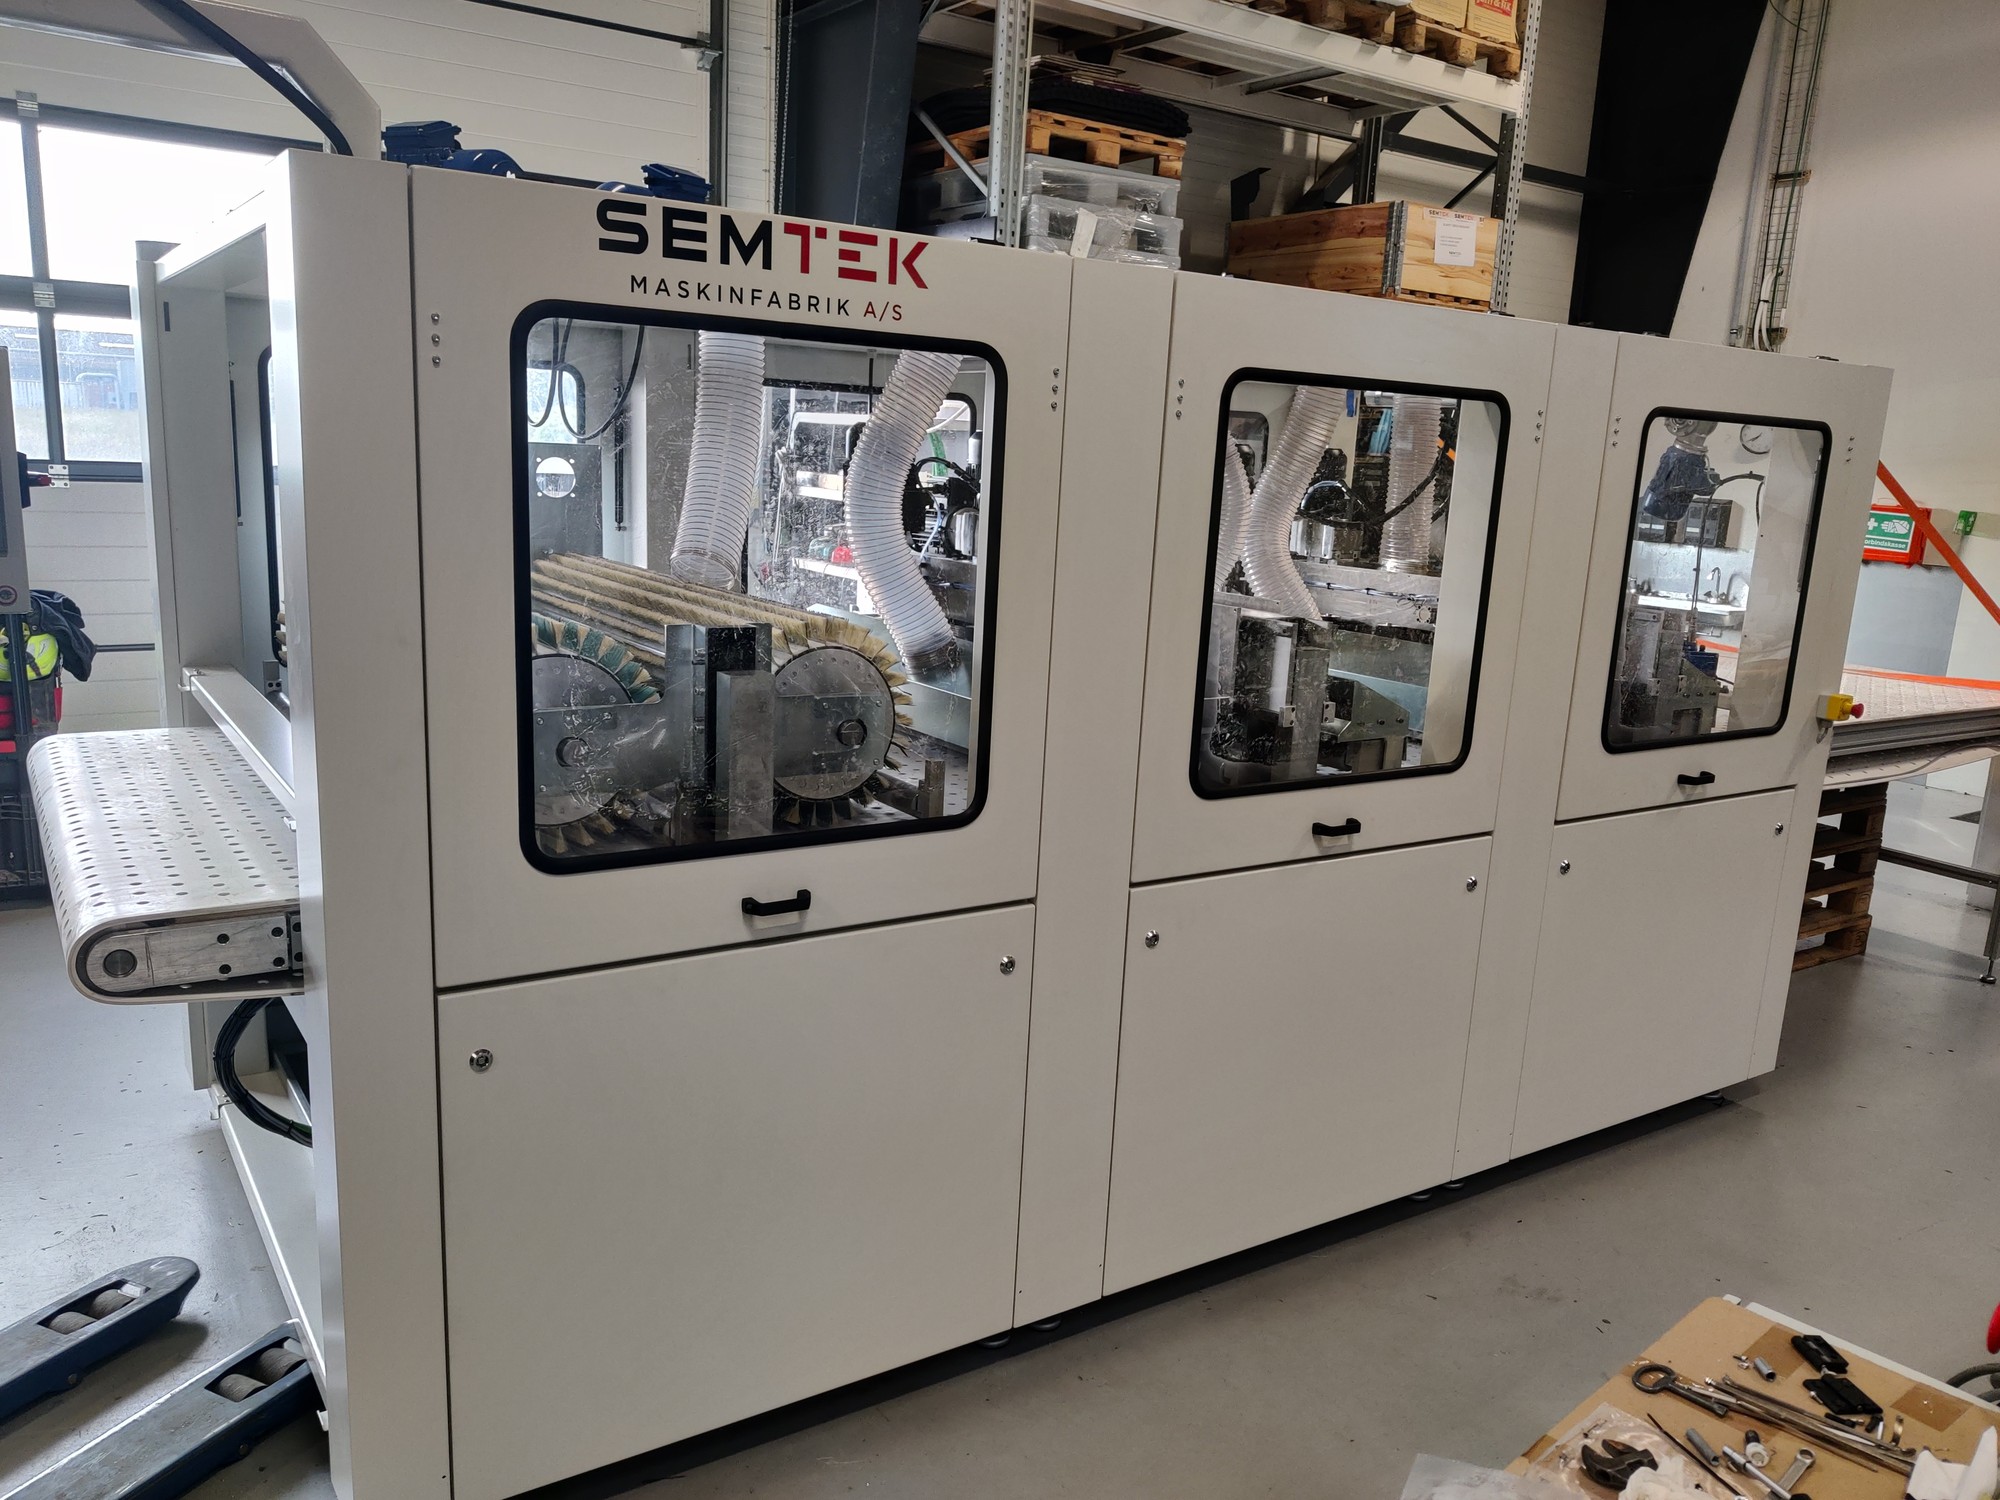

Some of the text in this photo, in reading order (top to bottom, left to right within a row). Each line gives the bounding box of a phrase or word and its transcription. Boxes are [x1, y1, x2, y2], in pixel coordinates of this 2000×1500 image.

[596, 198, 929, 289] SEMTEK
[630, 274, 903, 322] MASKINFABRIK A/S
[1864, 539, 1906, 549] orbindskasse
